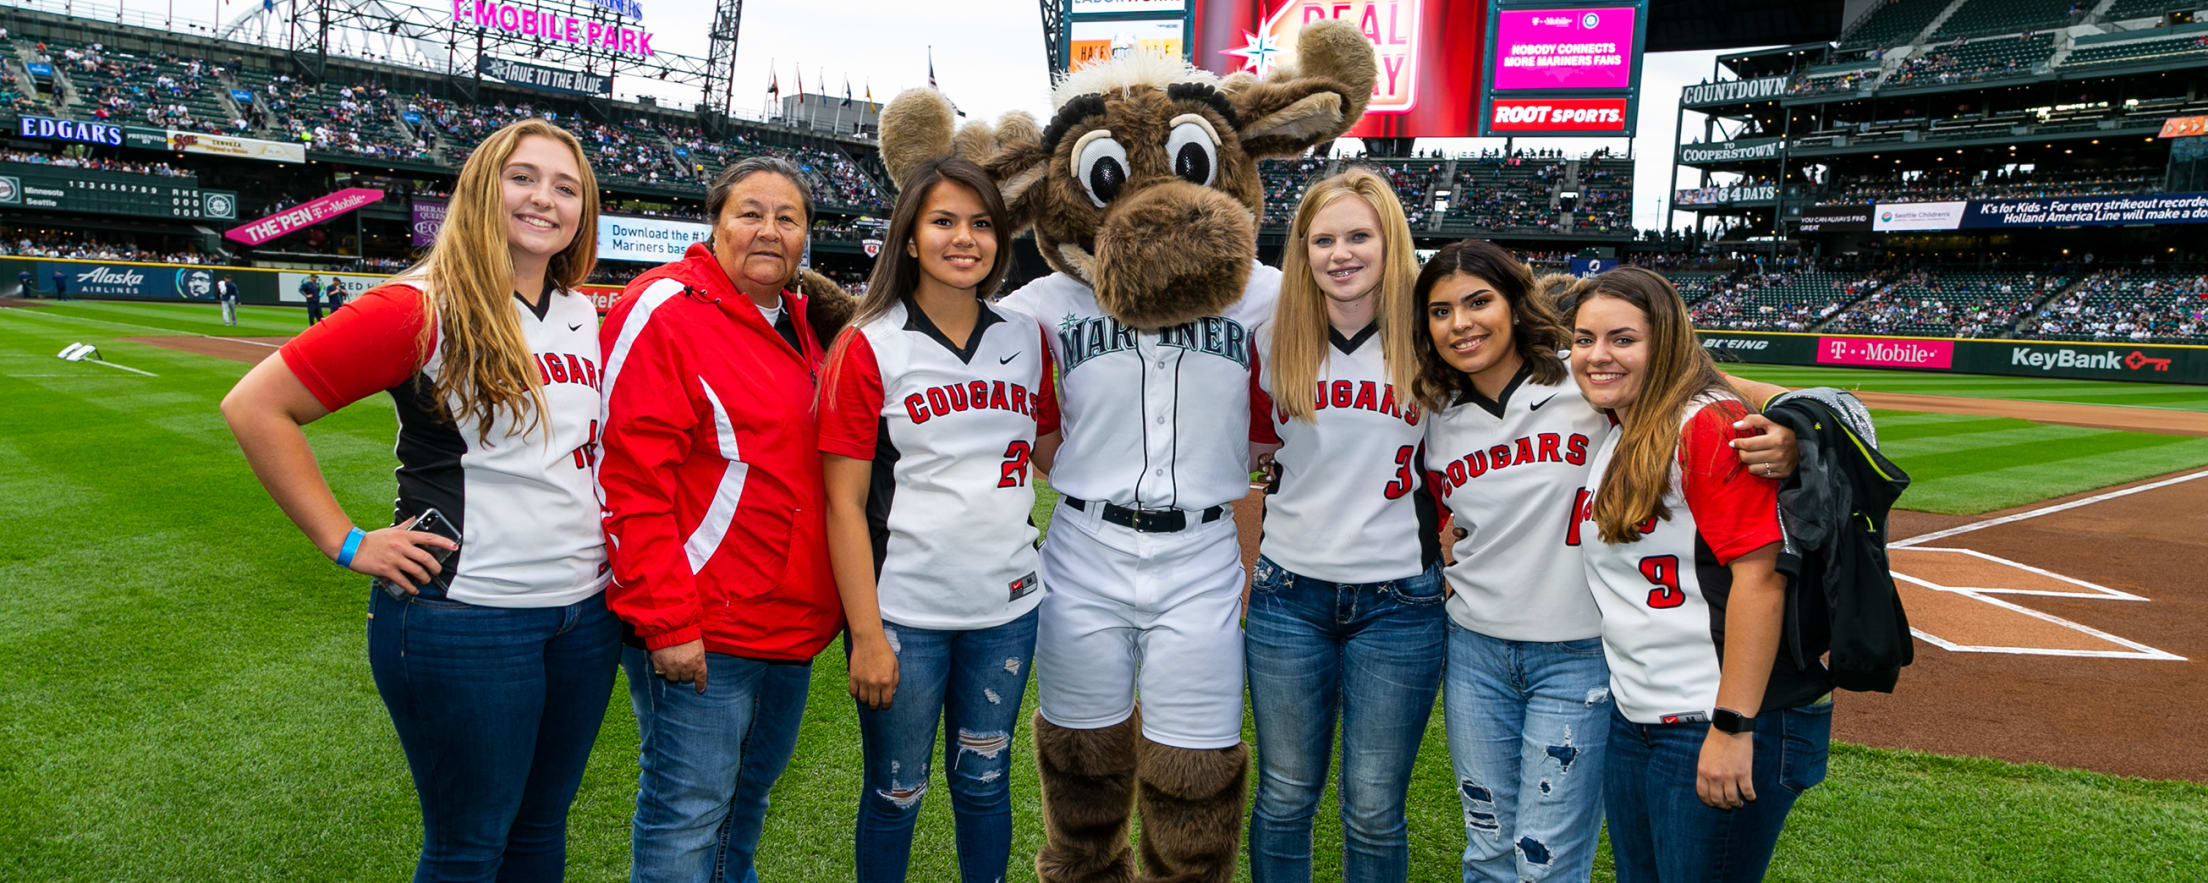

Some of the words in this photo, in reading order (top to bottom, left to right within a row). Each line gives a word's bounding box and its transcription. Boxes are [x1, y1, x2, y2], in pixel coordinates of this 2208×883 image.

[451, 0, 580, 43] T-MOBILE
[584, 20, 655, 57] PARK
[1512, 44, 1557, 55] NOBODY
[1557, 43, 1616, 54] CONNECTS
[1504, 57, 1536, 67] MORE
[1537, 56, 1592, 67] MARINERS
[1594, 54, 1622, 66] FANS
[505, 62, 534, 84] TRUE
[536, 70, 550, 86] TO
[552, 73, 573, 90] THE
[573, 72, 603, 93] BLUE
[1683, 77, 1788, 104] COUNTDOWN
[1494, 106, 1553, 124] ROOT
[1683, 142, 1776, 162] COOPERSTOWN
[1723, 142, 1735, 150] TO
[24, 186, 64, 197] Minnesota
[1743, 186, 1775, 200] DAYS
[26, 197, 57, 207] Seattle
[173, 198, 179, 206] 0
[1980, 203, 1998, 214] K's
[1999, 203, 2015, 213] for
[2017, 202, 2040, 213] Kids
[2050, 201, 2069, 212] For
[2071, 201, 2102, 214] every
[2103, 198, 2157, 210] strikeout
[2158, 195, 2208, 209] recorde
[174, 208, 180, 216] 0
[1827, 215, 1850, 223] ALWAYS
[2003, 212, 2046, 224] Holland
[2046, 211, 2093, 223] America
[2095, 210, 2121, 222] Line
[2123, 209, 2144, 221] will
[2145, 208, 2180, 220] make
[2181, 209, 2190, 219] a
[245, 219, 281, 242] THE
[612, 224, 668, 239] Download
[671, 230, 689, 241] the
[612, 239, 664, 253] Mariners
[867, 245, 877, 254] 42
[76, 266, 144, 285] Alaska
[82, 286, 139, 294] AIRLINES
[2011, 347, 2122, 370] KeyBank
[904, 380, 1038, 425] COUGARS
[1384, 445, 1415, 500] 3
[1638, 554, 1686, 609] 9
